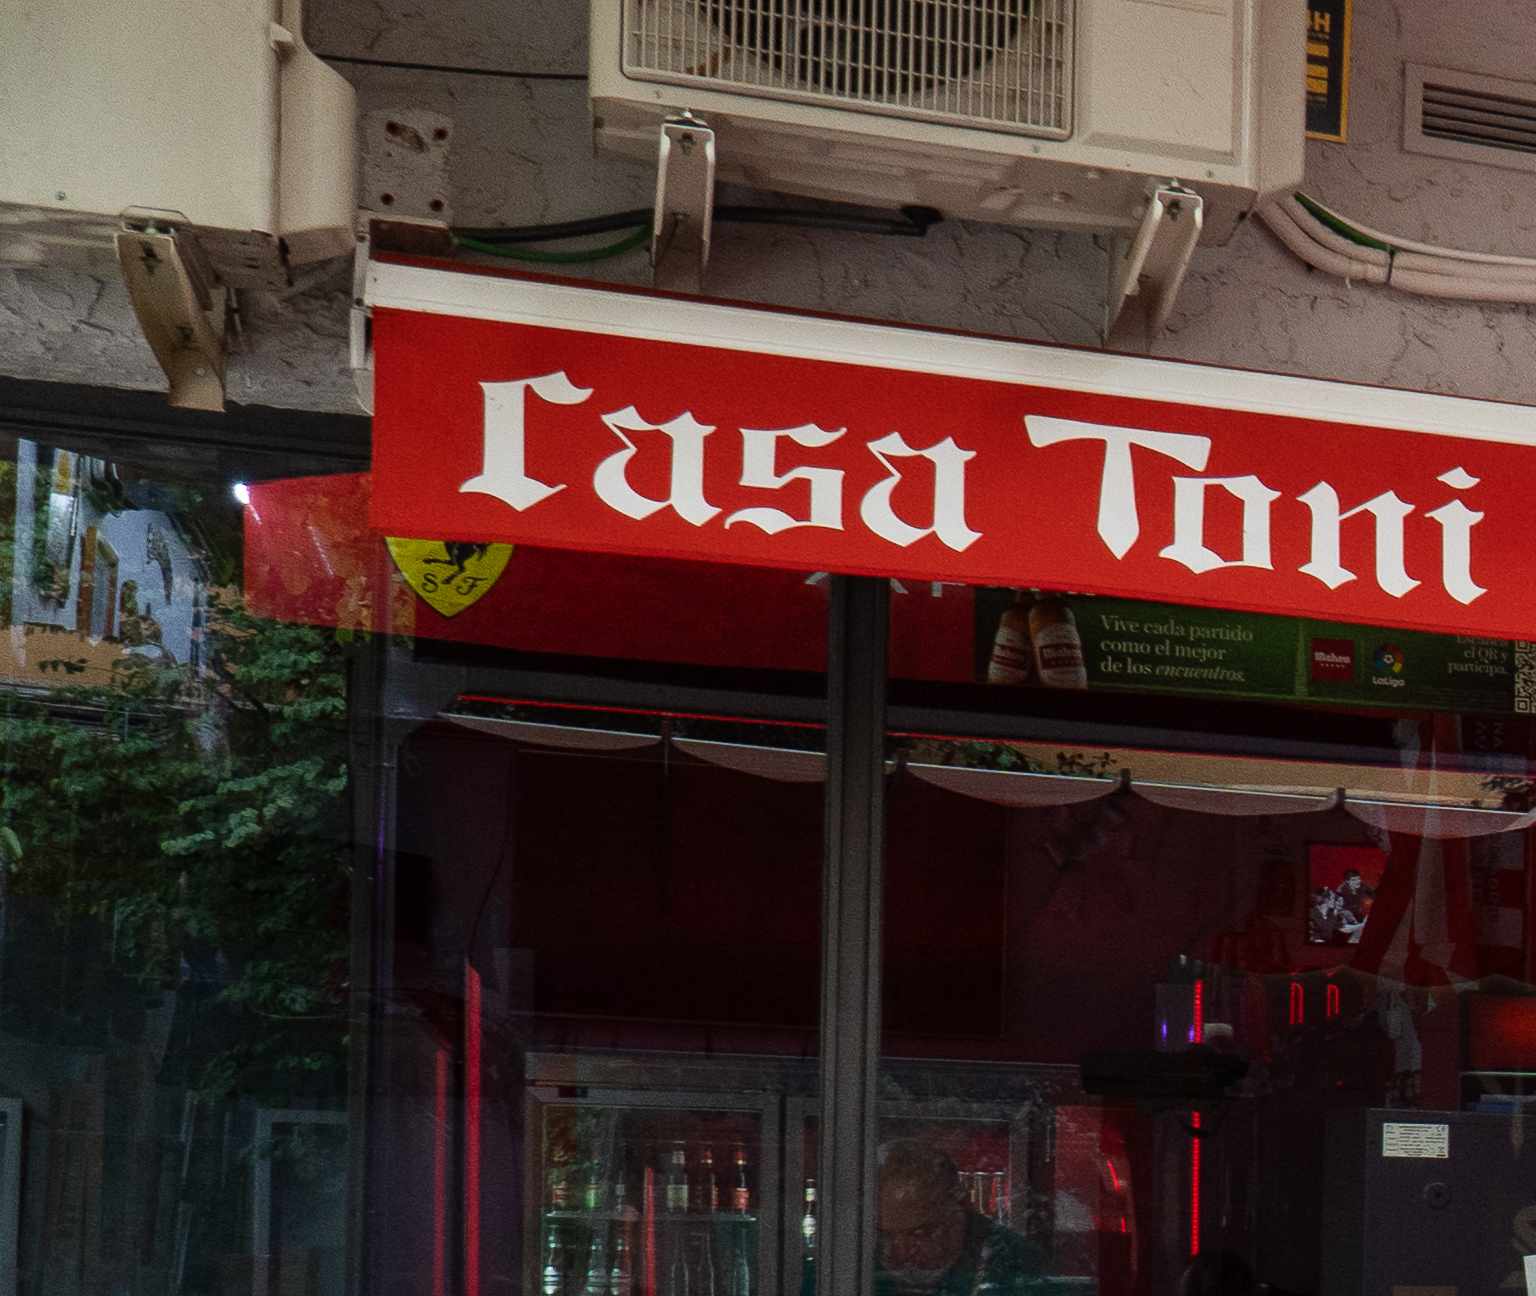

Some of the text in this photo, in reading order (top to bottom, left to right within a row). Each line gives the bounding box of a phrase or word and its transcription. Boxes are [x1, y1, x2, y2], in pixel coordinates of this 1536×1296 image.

[459, 370, 1486, 605] Casa Toni
[1100, 614, 1253, 642] Vive cada partido
[1100, 639, 1227, 662] como el mejor
[1100, 656, 1122, 673] de
[1127, 657, 1152, 674] los
